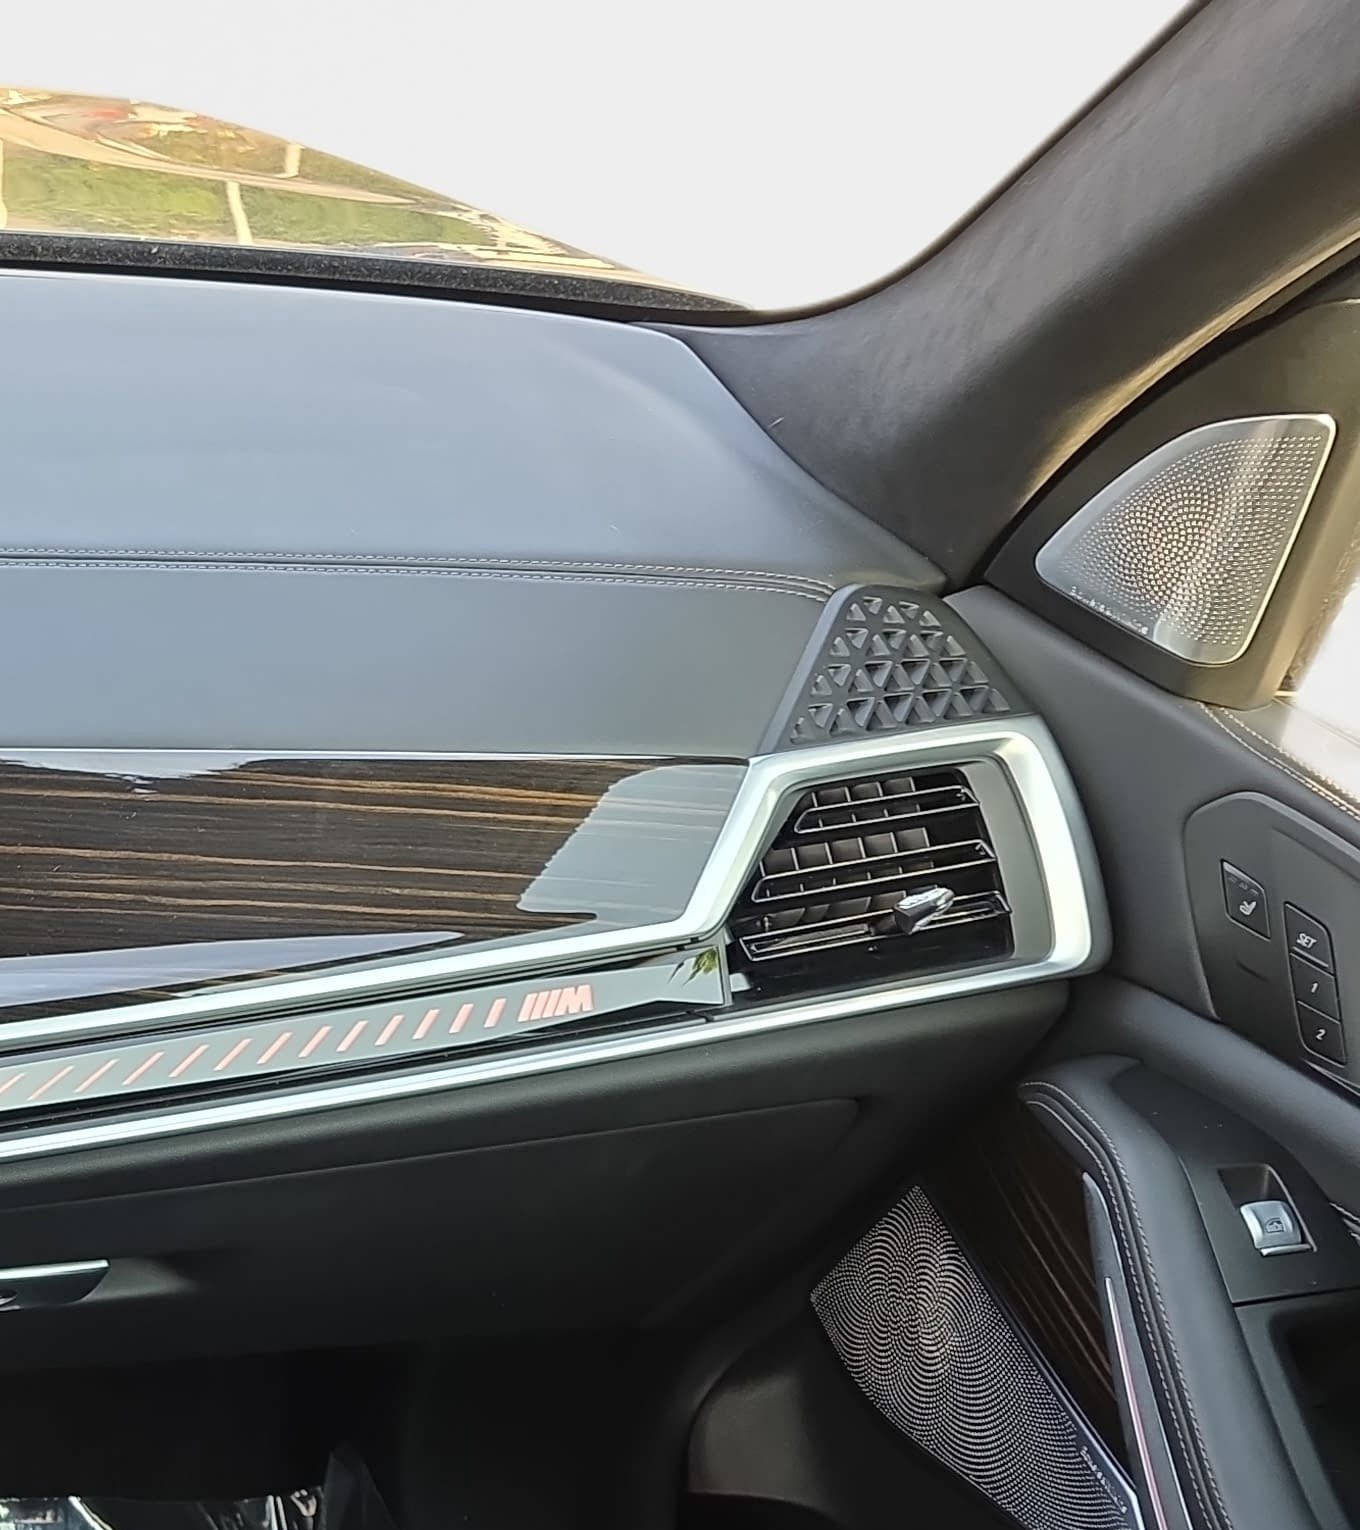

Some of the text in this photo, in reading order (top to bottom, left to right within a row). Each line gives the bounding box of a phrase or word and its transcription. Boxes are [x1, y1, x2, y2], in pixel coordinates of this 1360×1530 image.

[1296, 932, 1318, 949] SET
[1310, 982, 1319, 993] 1
[1315, 1028, 1327, 1041] 2
